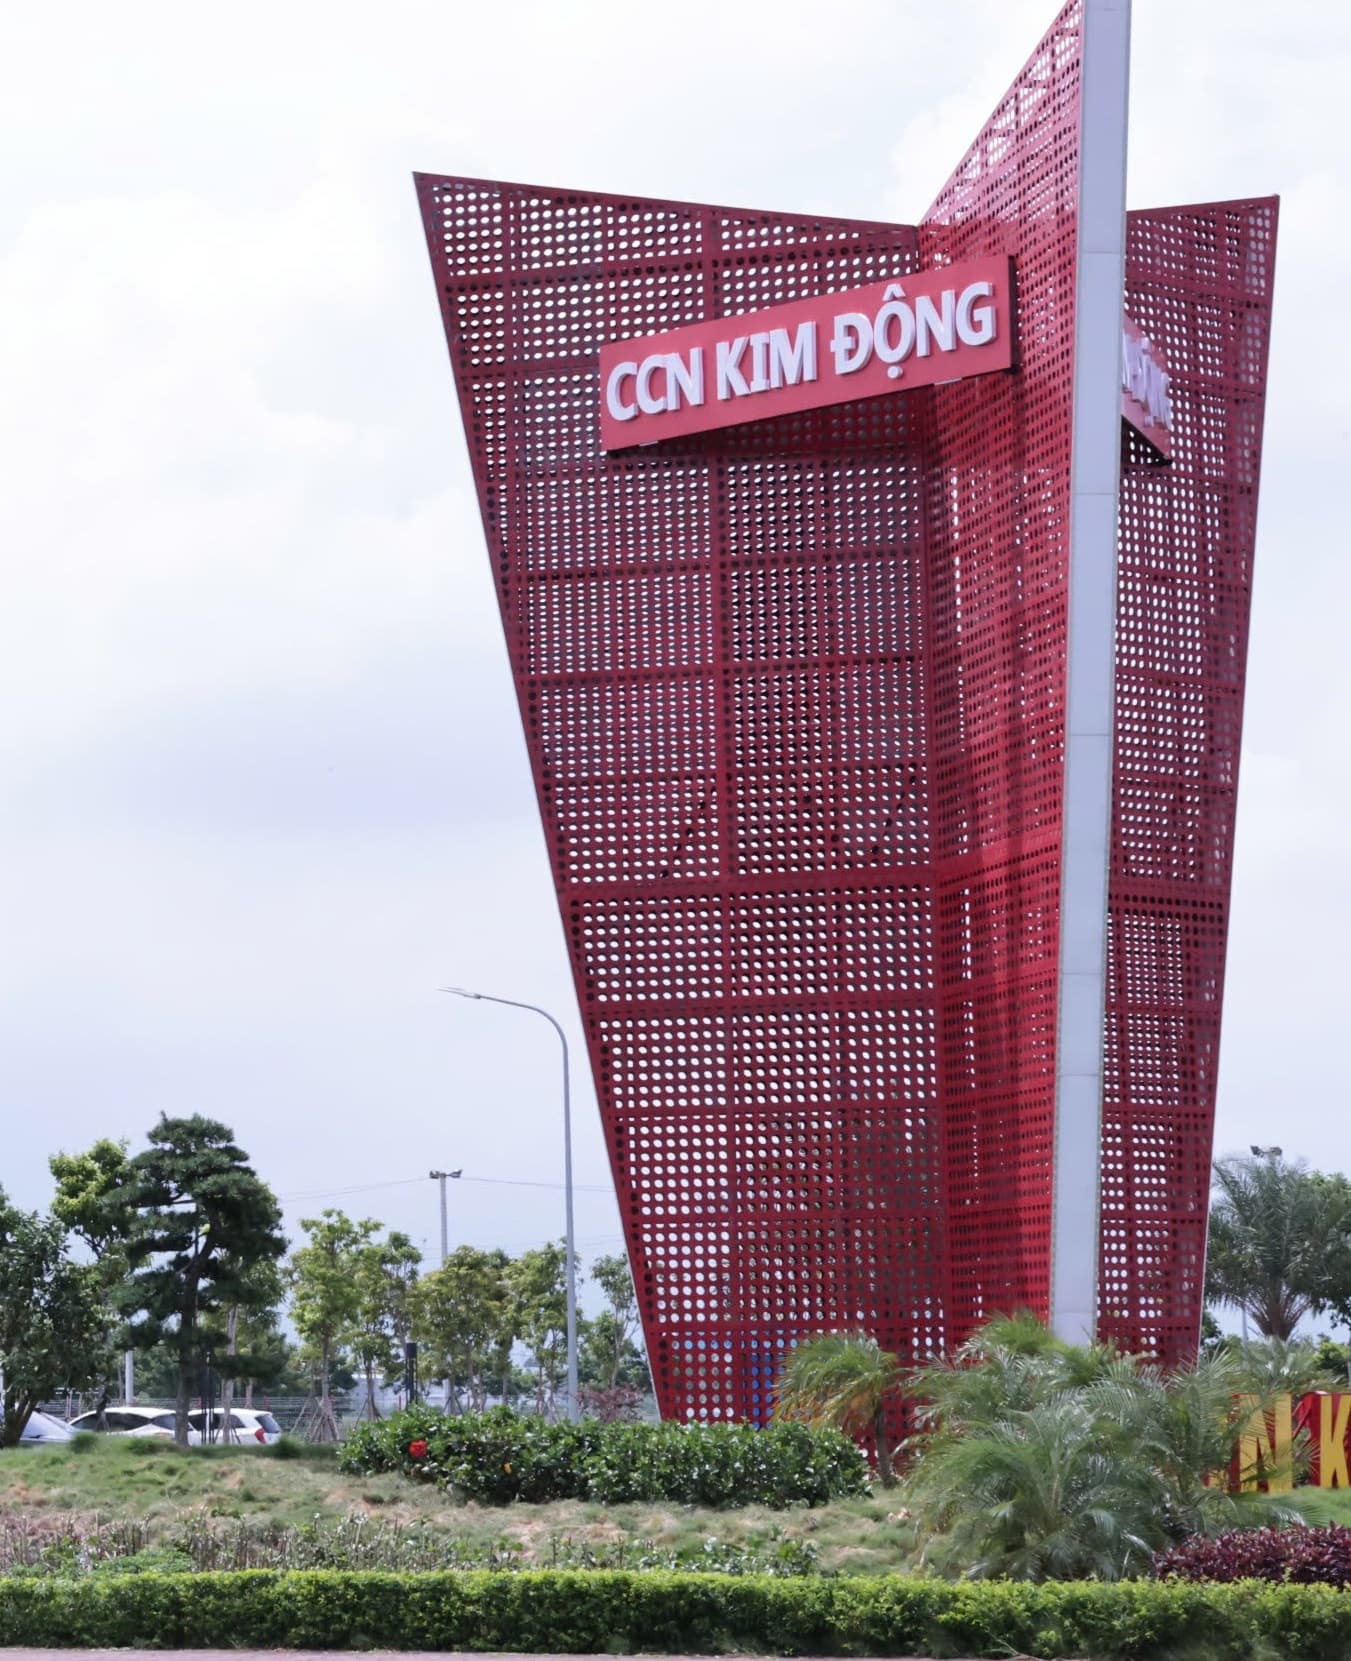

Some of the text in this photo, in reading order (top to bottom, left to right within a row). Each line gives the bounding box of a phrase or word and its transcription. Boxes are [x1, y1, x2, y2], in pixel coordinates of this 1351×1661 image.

[606, 281, 998, 421] CCN KIM ĐỘNG
